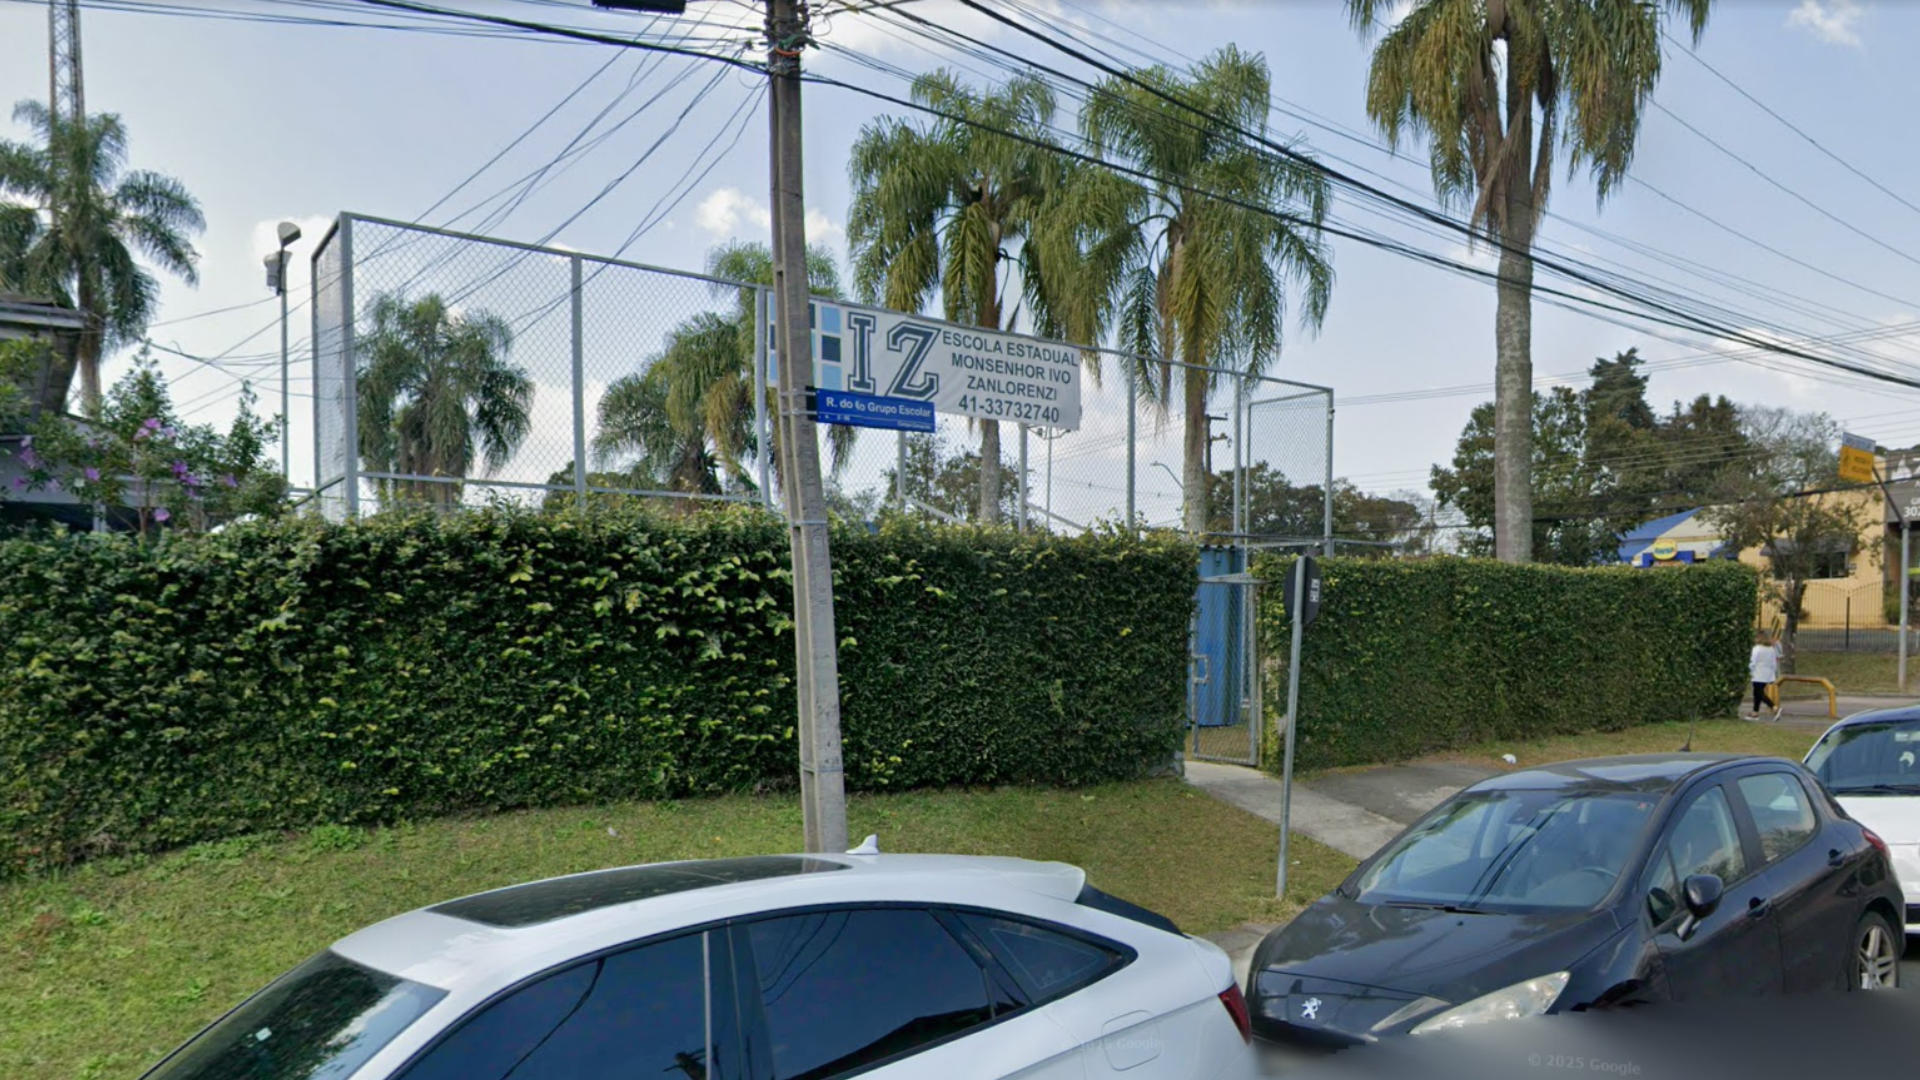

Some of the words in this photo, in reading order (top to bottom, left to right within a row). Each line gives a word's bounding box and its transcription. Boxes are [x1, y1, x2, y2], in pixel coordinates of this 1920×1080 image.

[942, 331, 1003, 354] ESCOLA
[1006, 342, 1079, 367] ESTADUAL
[951, 352, 1045, 381] MONSENHOR
[1049, 368, 1071, 384] IVO
[967, 375, 1057, 401] ZANLORENZI
[826, 397, 838, 408] R.
[839, 399, 853, 409] do
[867, 402, 897, 416] Grupo
[899, 405, 931, 417] Escolar
[958, 394, 1059, 423] 41-33732740
